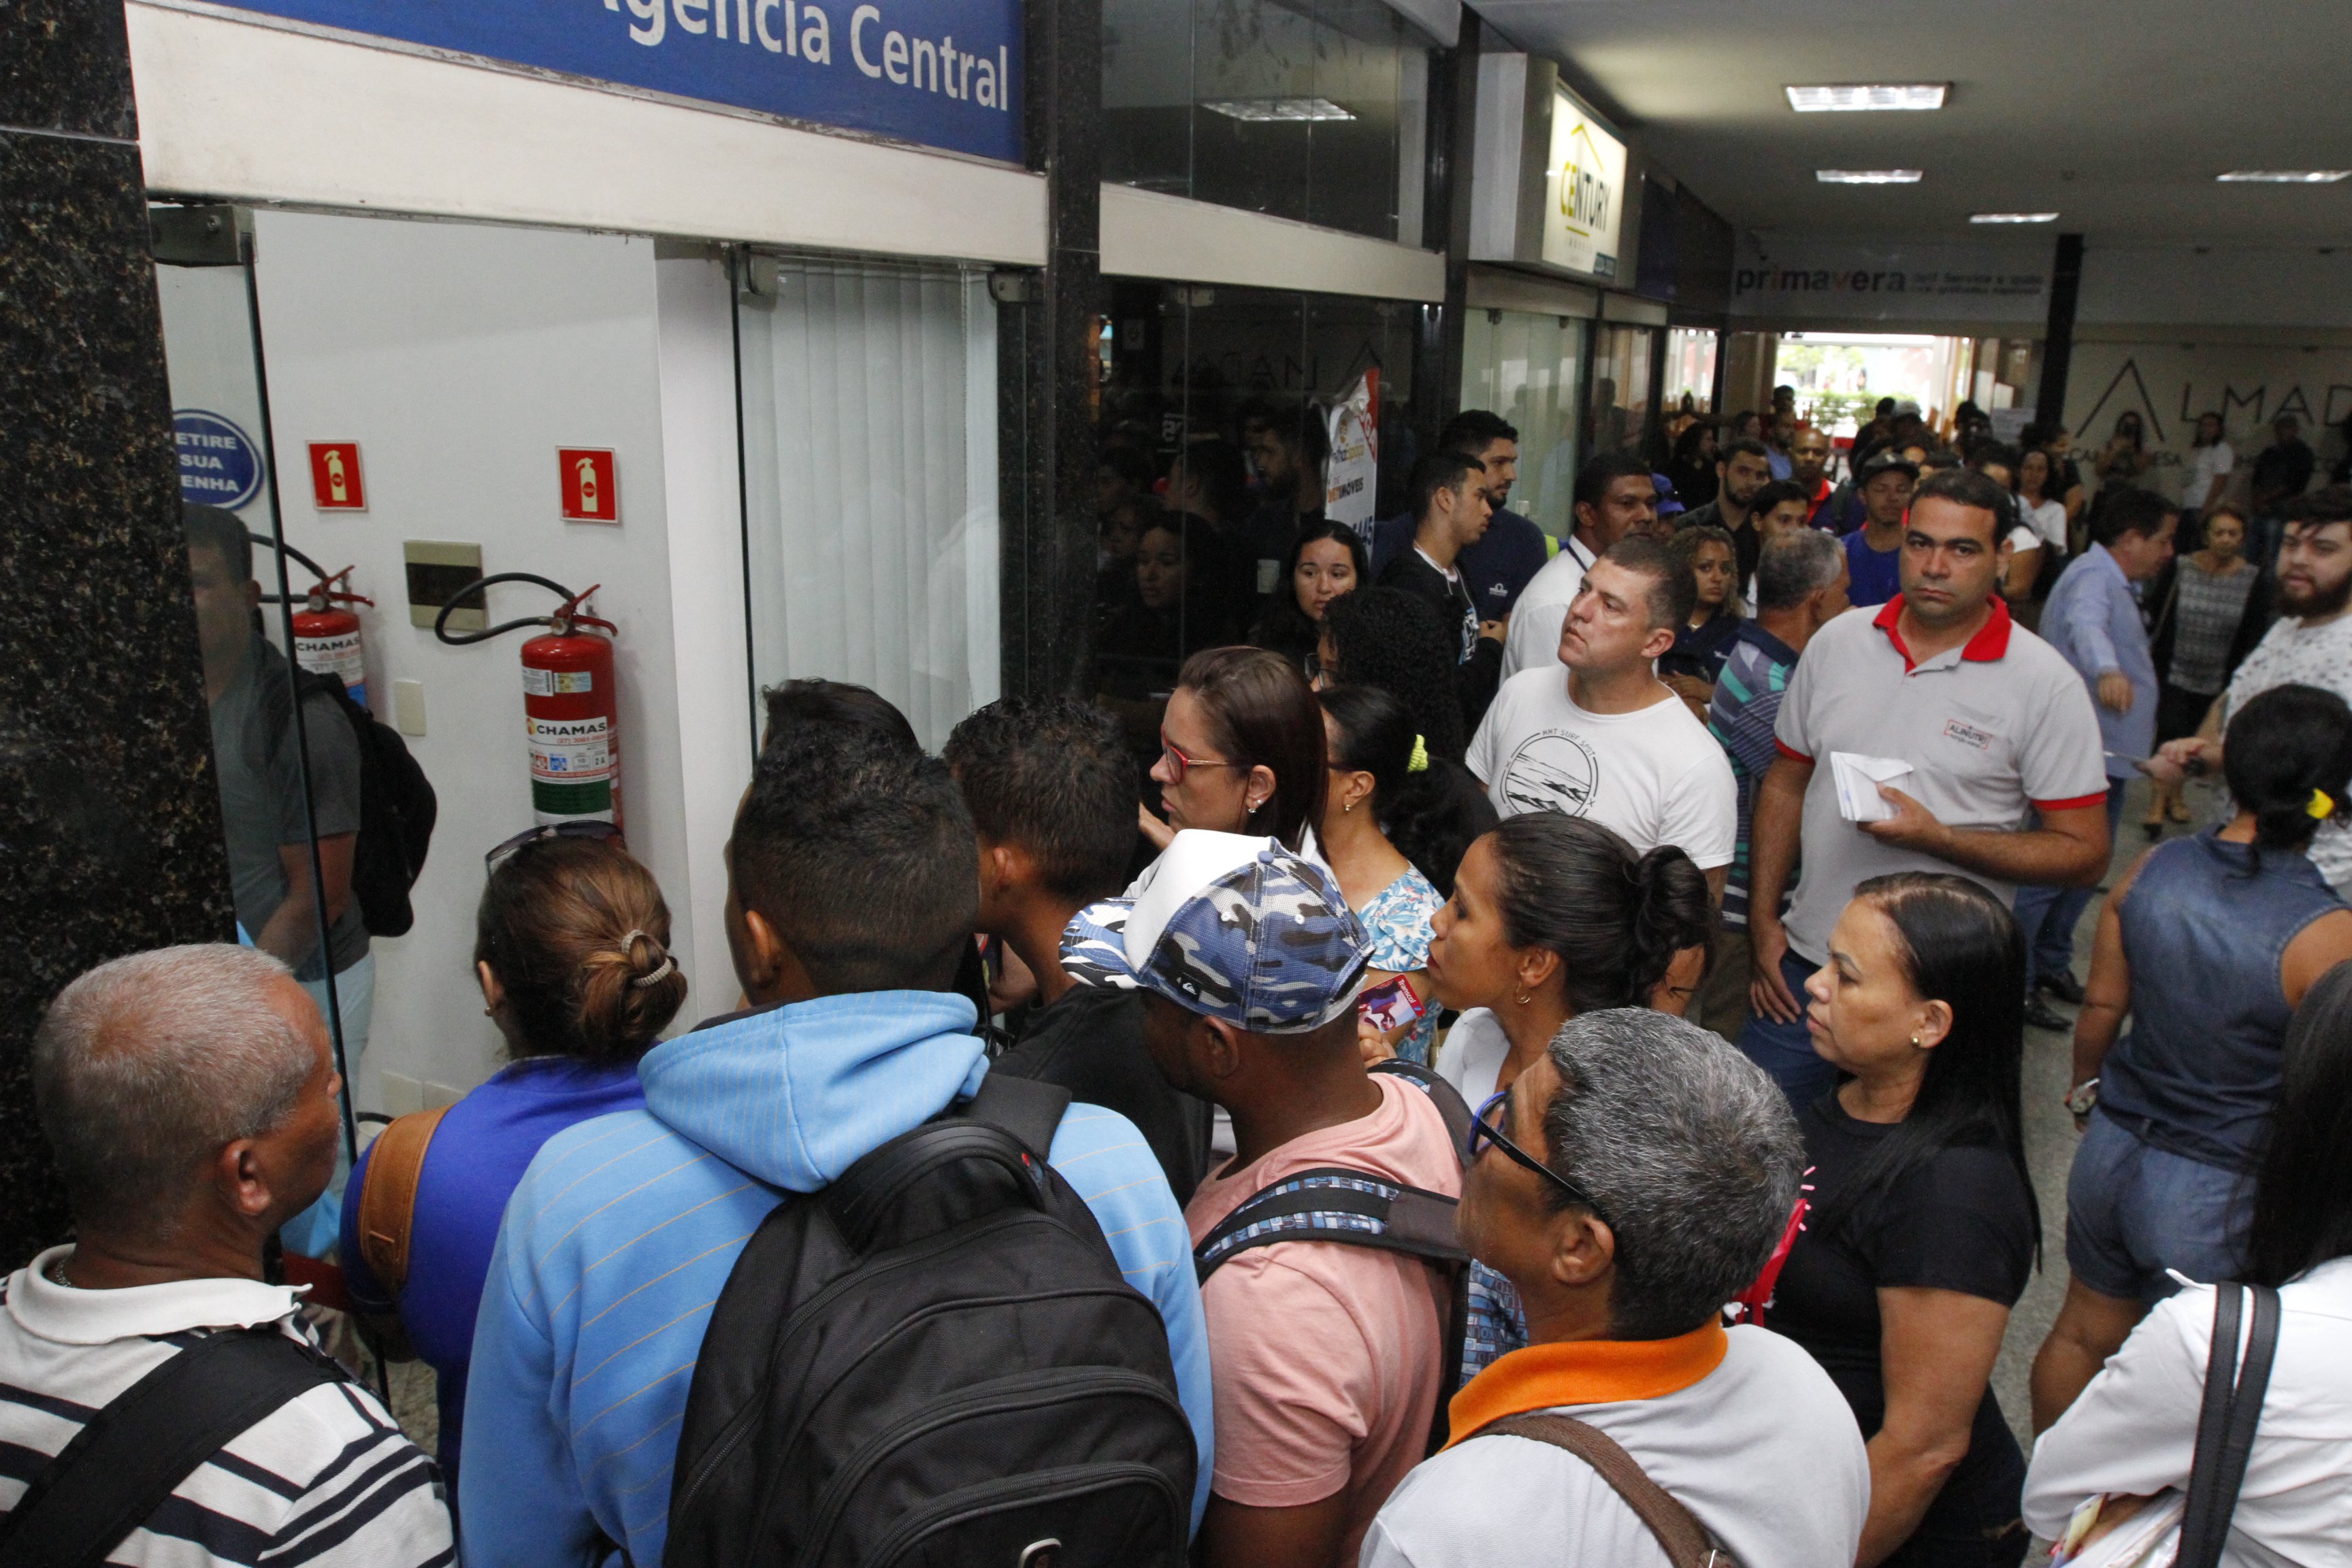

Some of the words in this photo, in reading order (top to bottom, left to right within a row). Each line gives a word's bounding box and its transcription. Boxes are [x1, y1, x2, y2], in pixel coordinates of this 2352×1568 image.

[850, 5, 1008, 111] Central
[1735, 266, 1906, 296] primavera
[176, 432, 238, 450] ETIRE
[179, 454, 224, 470] SUA
[180, 475, 240, 493] ENHA
[297, 638, 359, 651] CHAMAS
[537, 723, 606, 736] CHAMAS
[1560, 730, 1580, 740] SURF
[1580, 740, 1596, 757] SPOT
[1399, 979, 1417, 1004] Transcol
